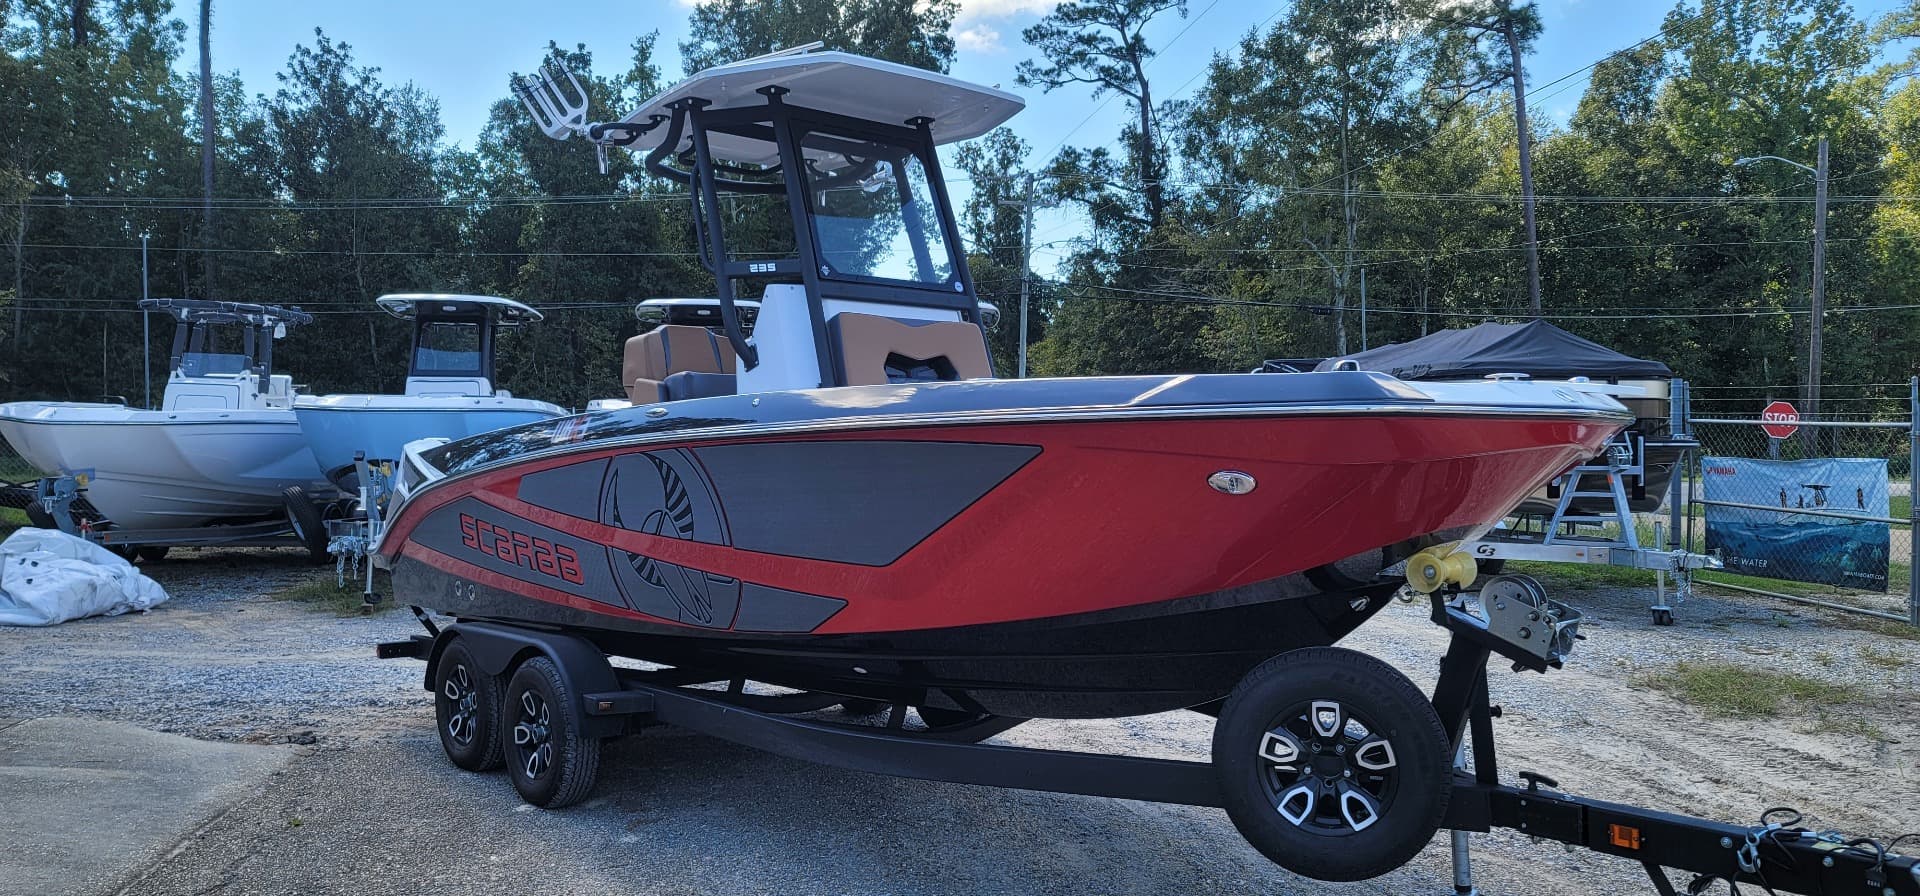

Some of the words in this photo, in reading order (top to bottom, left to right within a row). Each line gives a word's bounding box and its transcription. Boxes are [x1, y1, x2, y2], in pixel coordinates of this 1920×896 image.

[749, 263, 776, 273] 235
[1765, 412, 1796, 427] STOP
[1713, 466, 1736, 476] YAMAHA
[1477, 544, 1496, 557] G3
[1741, 558, 1768, 568] WATER
